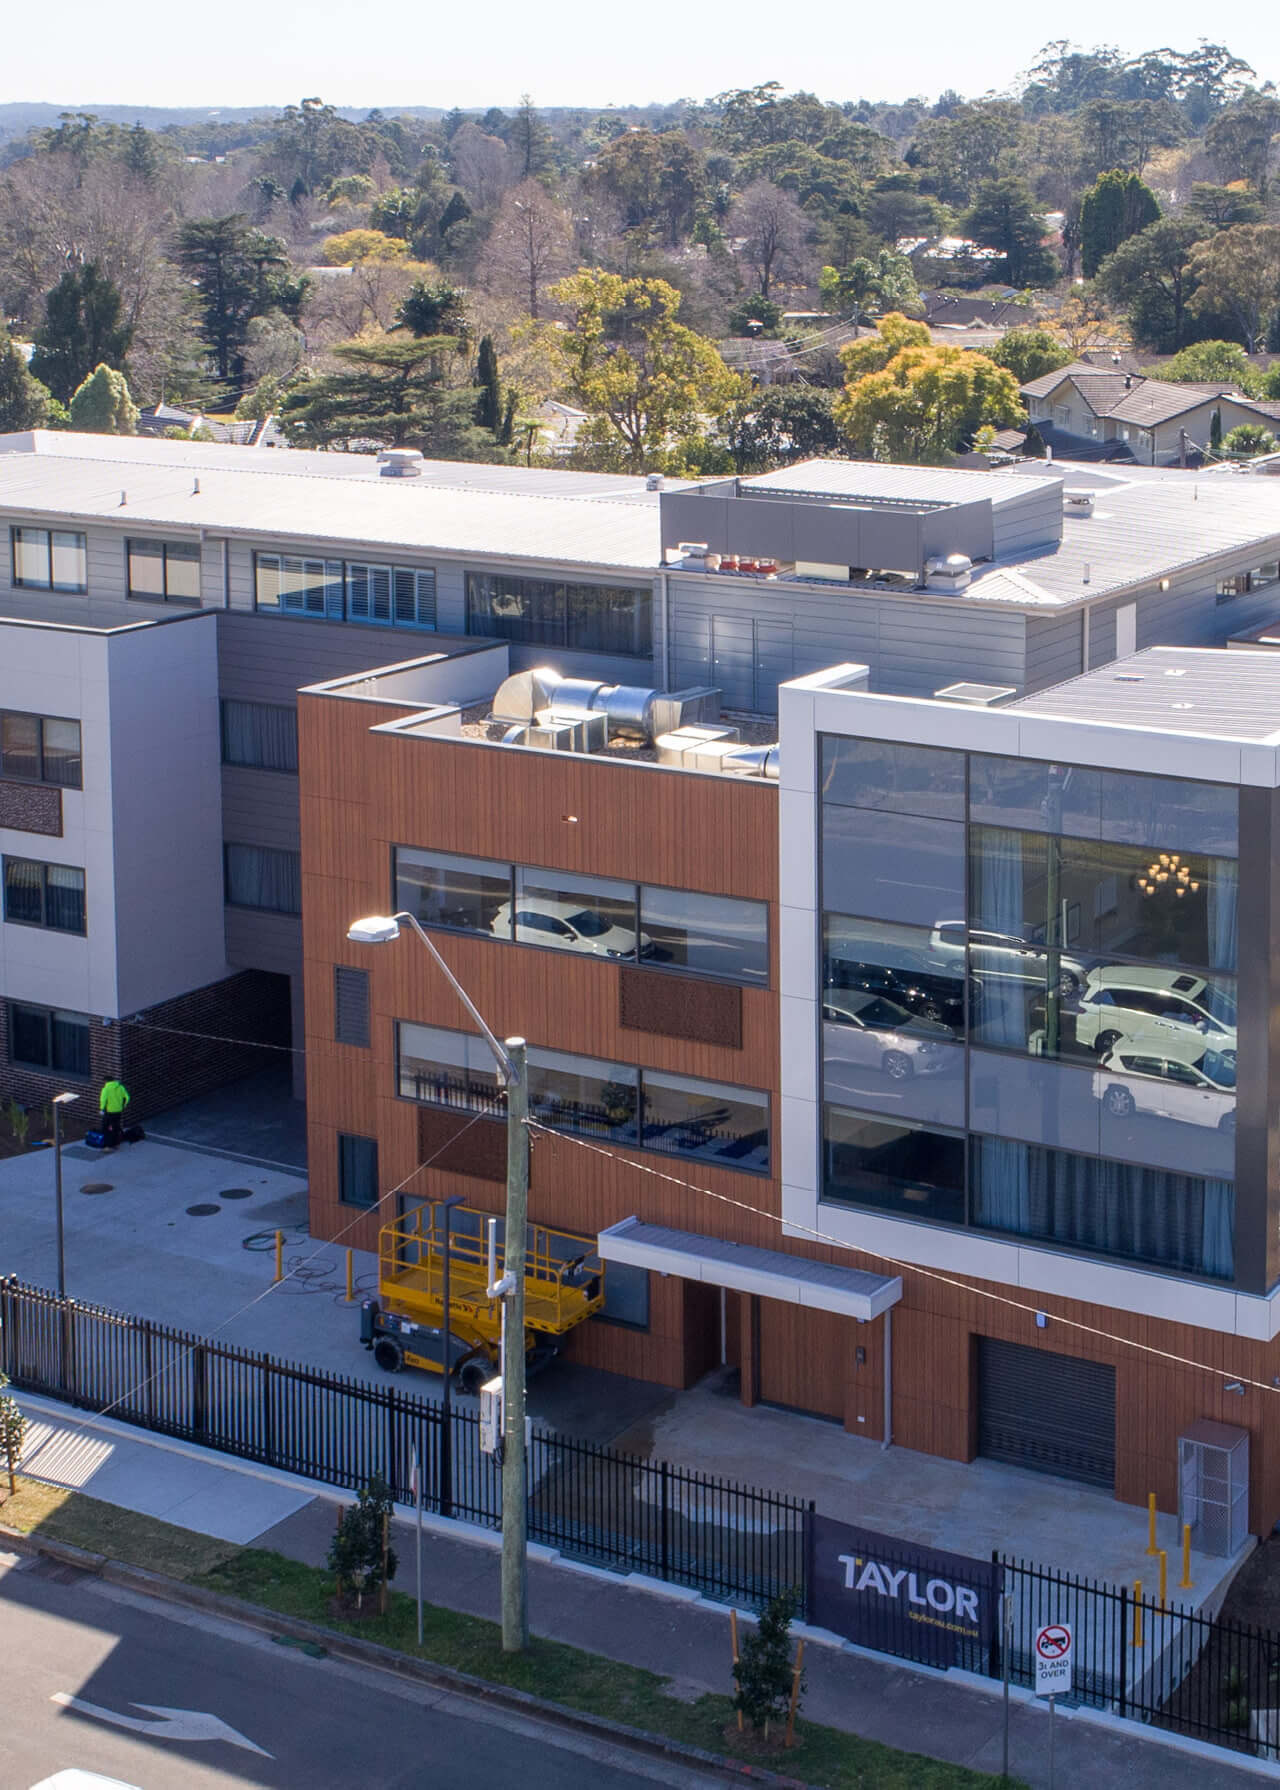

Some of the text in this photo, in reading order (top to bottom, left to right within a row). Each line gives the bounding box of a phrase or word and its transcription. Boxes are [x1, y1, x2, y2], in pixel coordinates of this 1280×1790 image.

[838, 1554, 979, 1623] TAYLOR
[1050, 1660, 1069, 1669] AND
[1041, 1669, 1066, 1679] OVER
